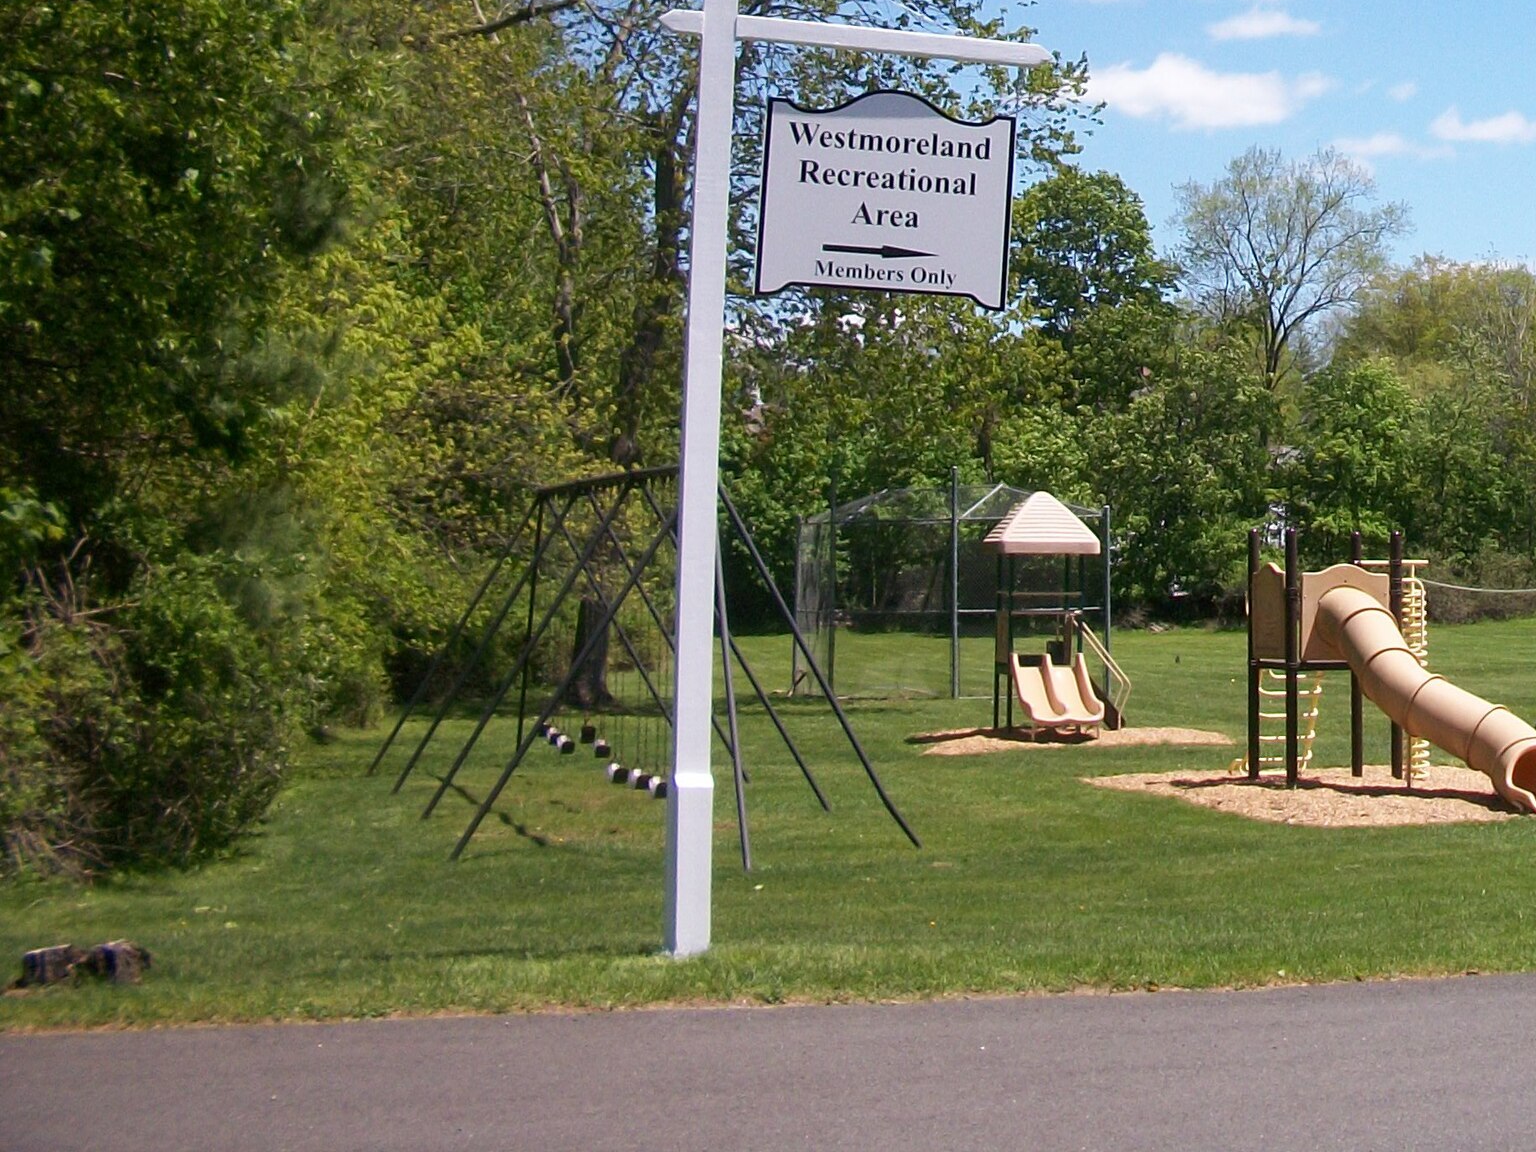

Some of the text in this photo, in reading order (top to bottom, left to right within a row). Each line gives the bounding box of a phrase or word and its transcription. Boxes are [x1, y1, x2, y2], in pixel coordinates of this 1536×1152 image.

[789, 122, 991, 160] Westmoreland
[798, 159, 977, 196] Recreational
[851, 201, 919, 228] Area
[815, 260, 957, 289] Members Only
